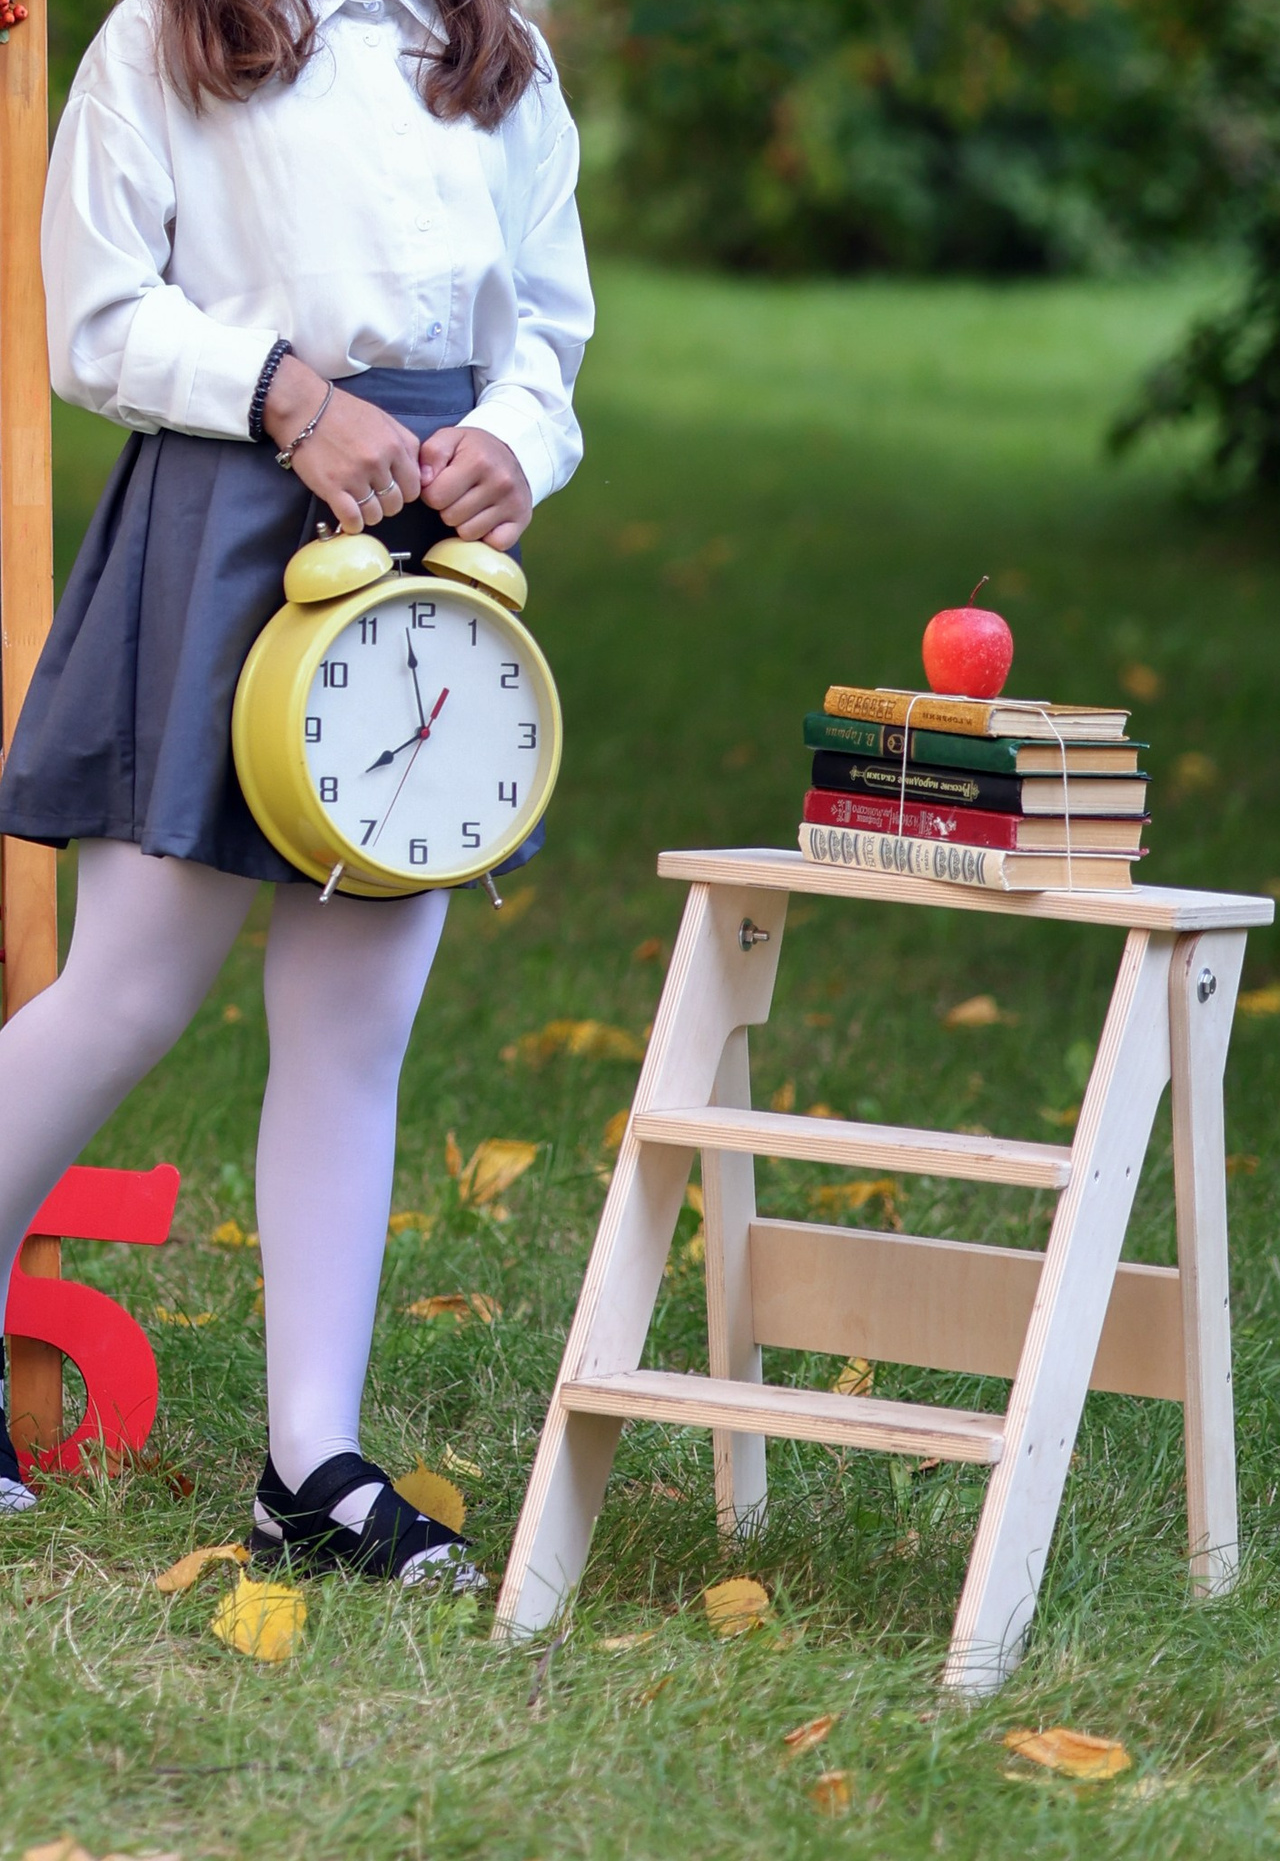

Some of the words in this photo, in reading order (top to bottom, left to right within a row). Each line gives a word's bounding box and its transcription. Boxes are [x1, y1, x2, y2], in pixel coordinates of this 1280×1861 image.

[408, 602, 436, 629] 12
[358, 617, 377, 645] 11
[468, 618, 477, 646] 1
[320, 660, 348, 688] 10
[500, 663, 519, 689] 2
[305, 717, 321, 743] 9
[517, 723, 537, 749] 3
[320, 776, 338, 803] 8
[866, 771, 896, 783] сказки
[940, 782, 971, 798] Русские
[498, 781, 517, 808] 4
[359, 820, 378, 846] 7
[461, 822, 481, 848] 5
[409, 839, 428, 865] 6
[4, 1163, 181, 1478] 5
